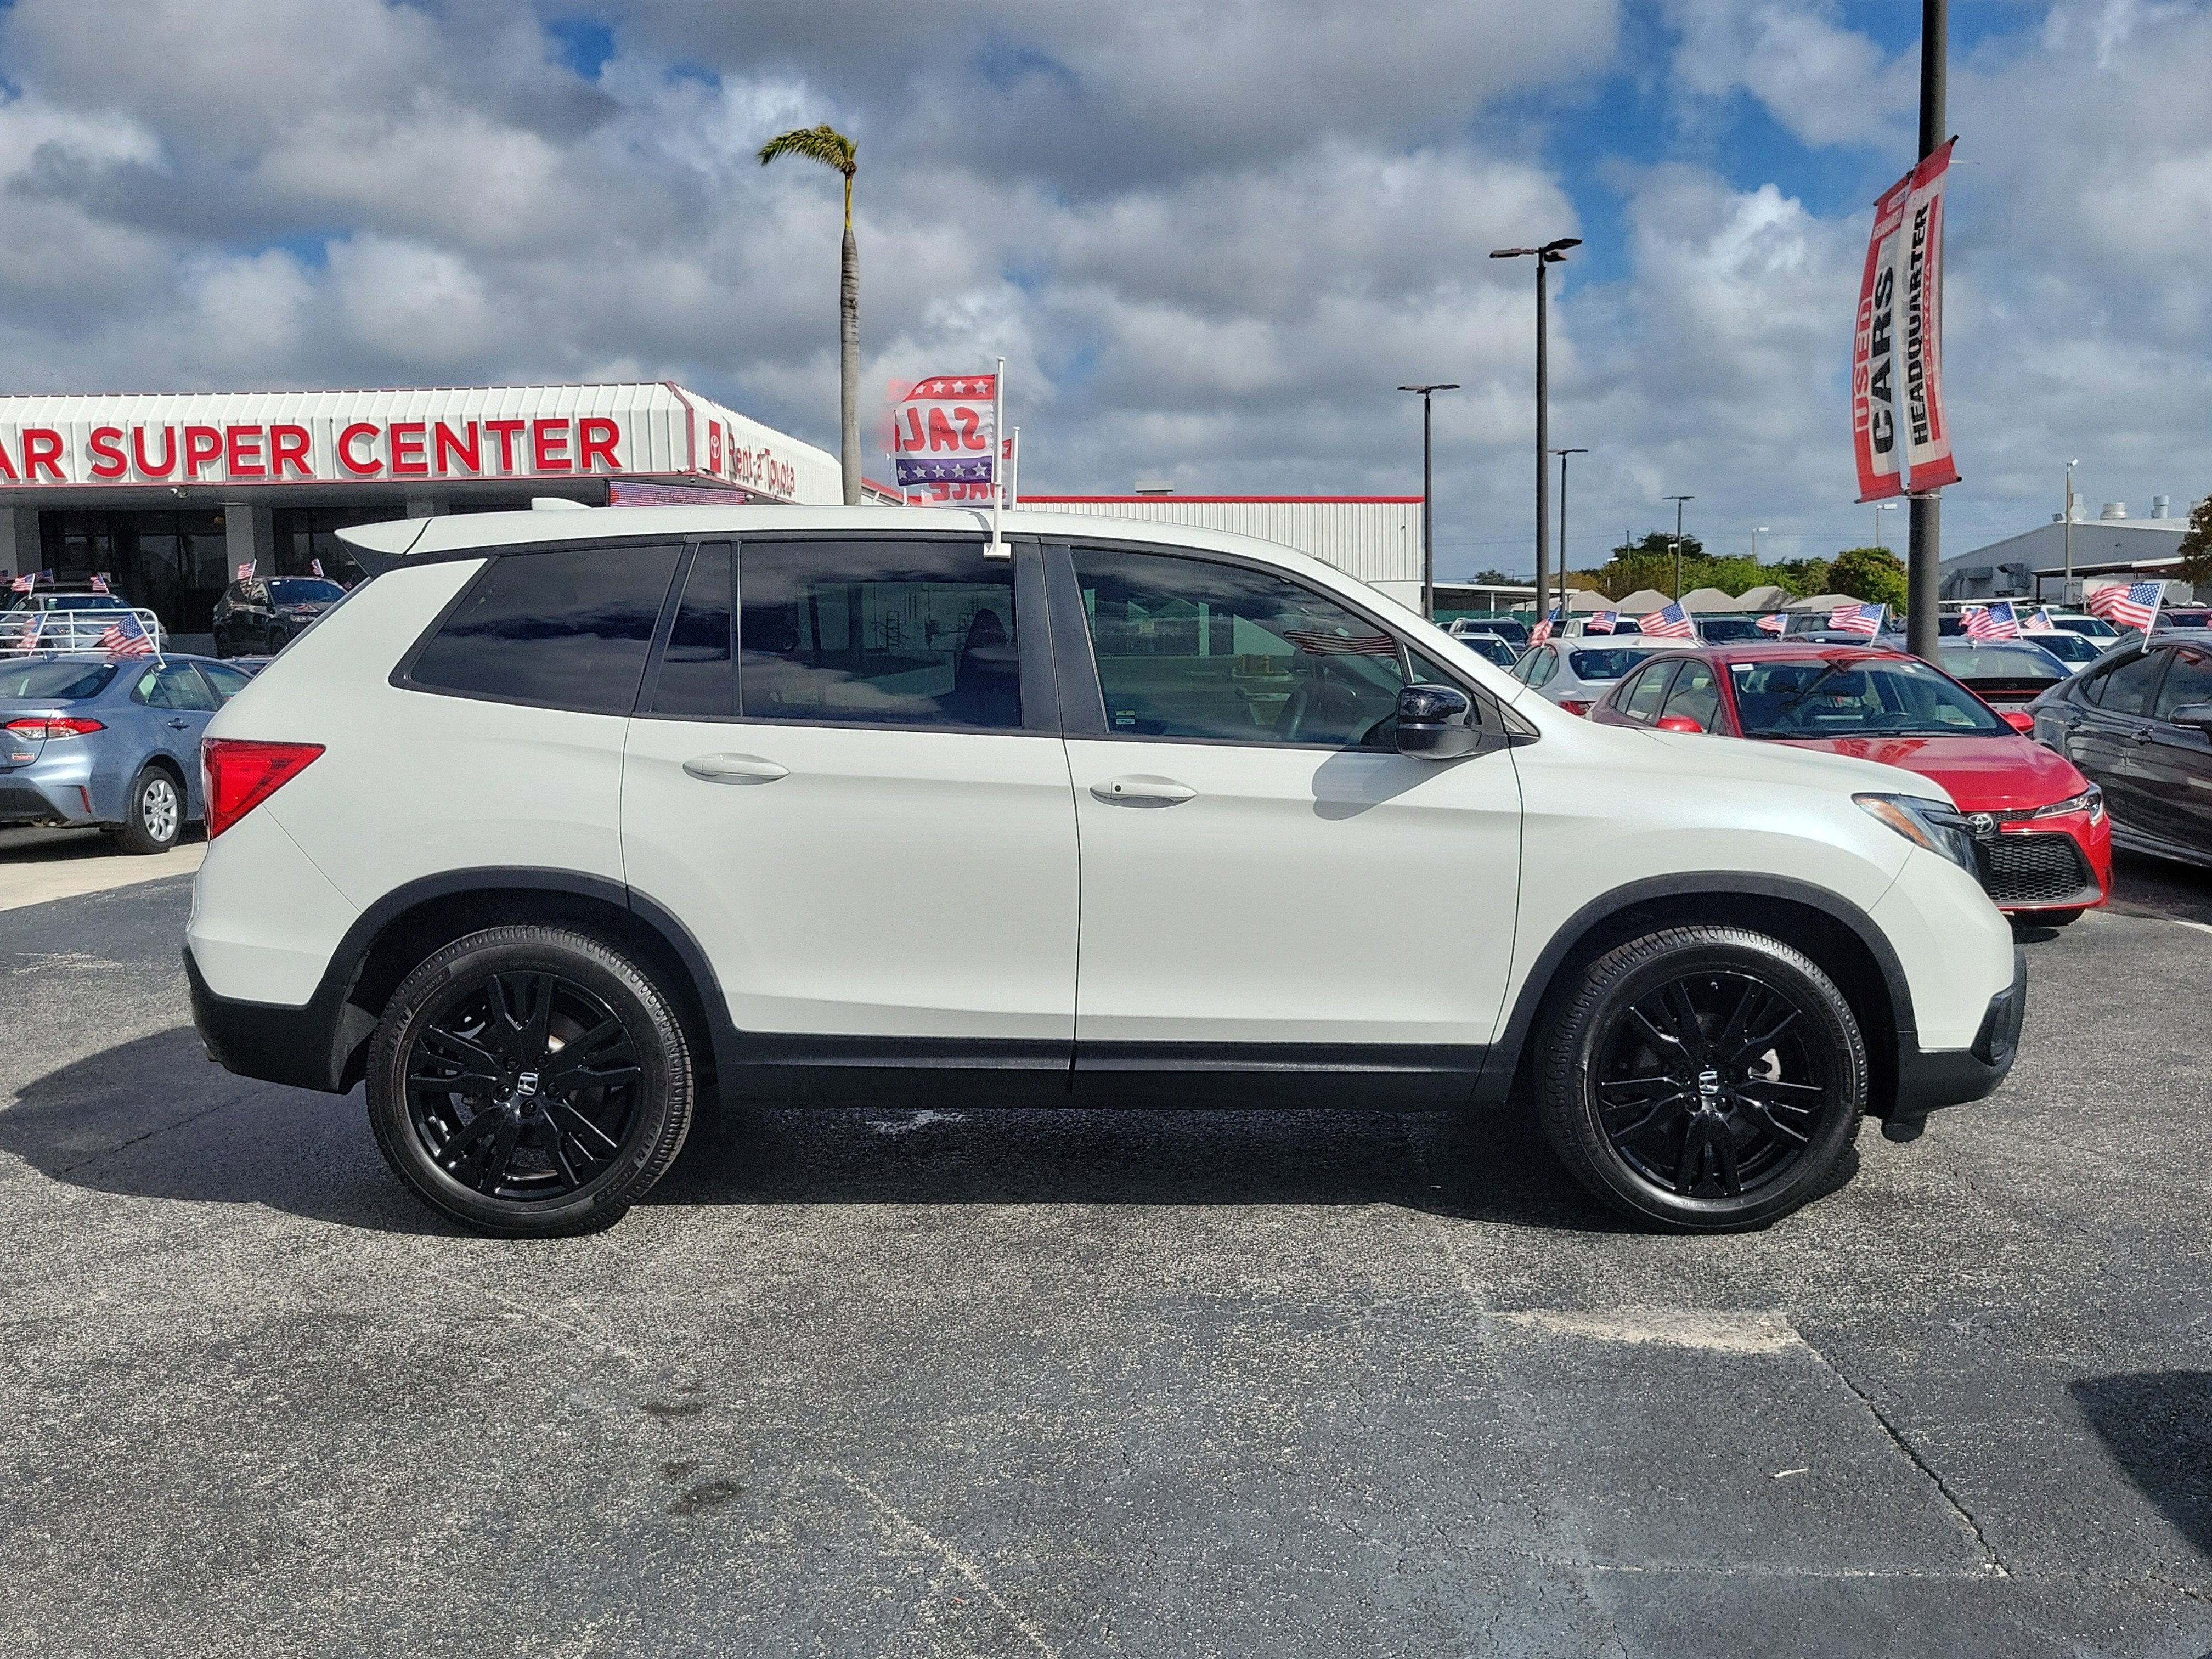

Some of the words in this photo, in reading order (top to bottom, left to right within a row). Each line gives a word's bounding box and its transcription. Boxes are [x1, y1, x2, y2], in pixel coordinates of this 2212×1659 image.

[1871, 266, 1893, 454] CARS
[1908, 202, 1929, 446] HEADQUARTER
[1922, 262, 1932, 353] TOYOTA
[1854, 297, 1872, 432] USED
[89, 424, 315, 478] SUPER
[337, 417, 624, 475] CENTER
[764, 448, 795, 493] Toyota
